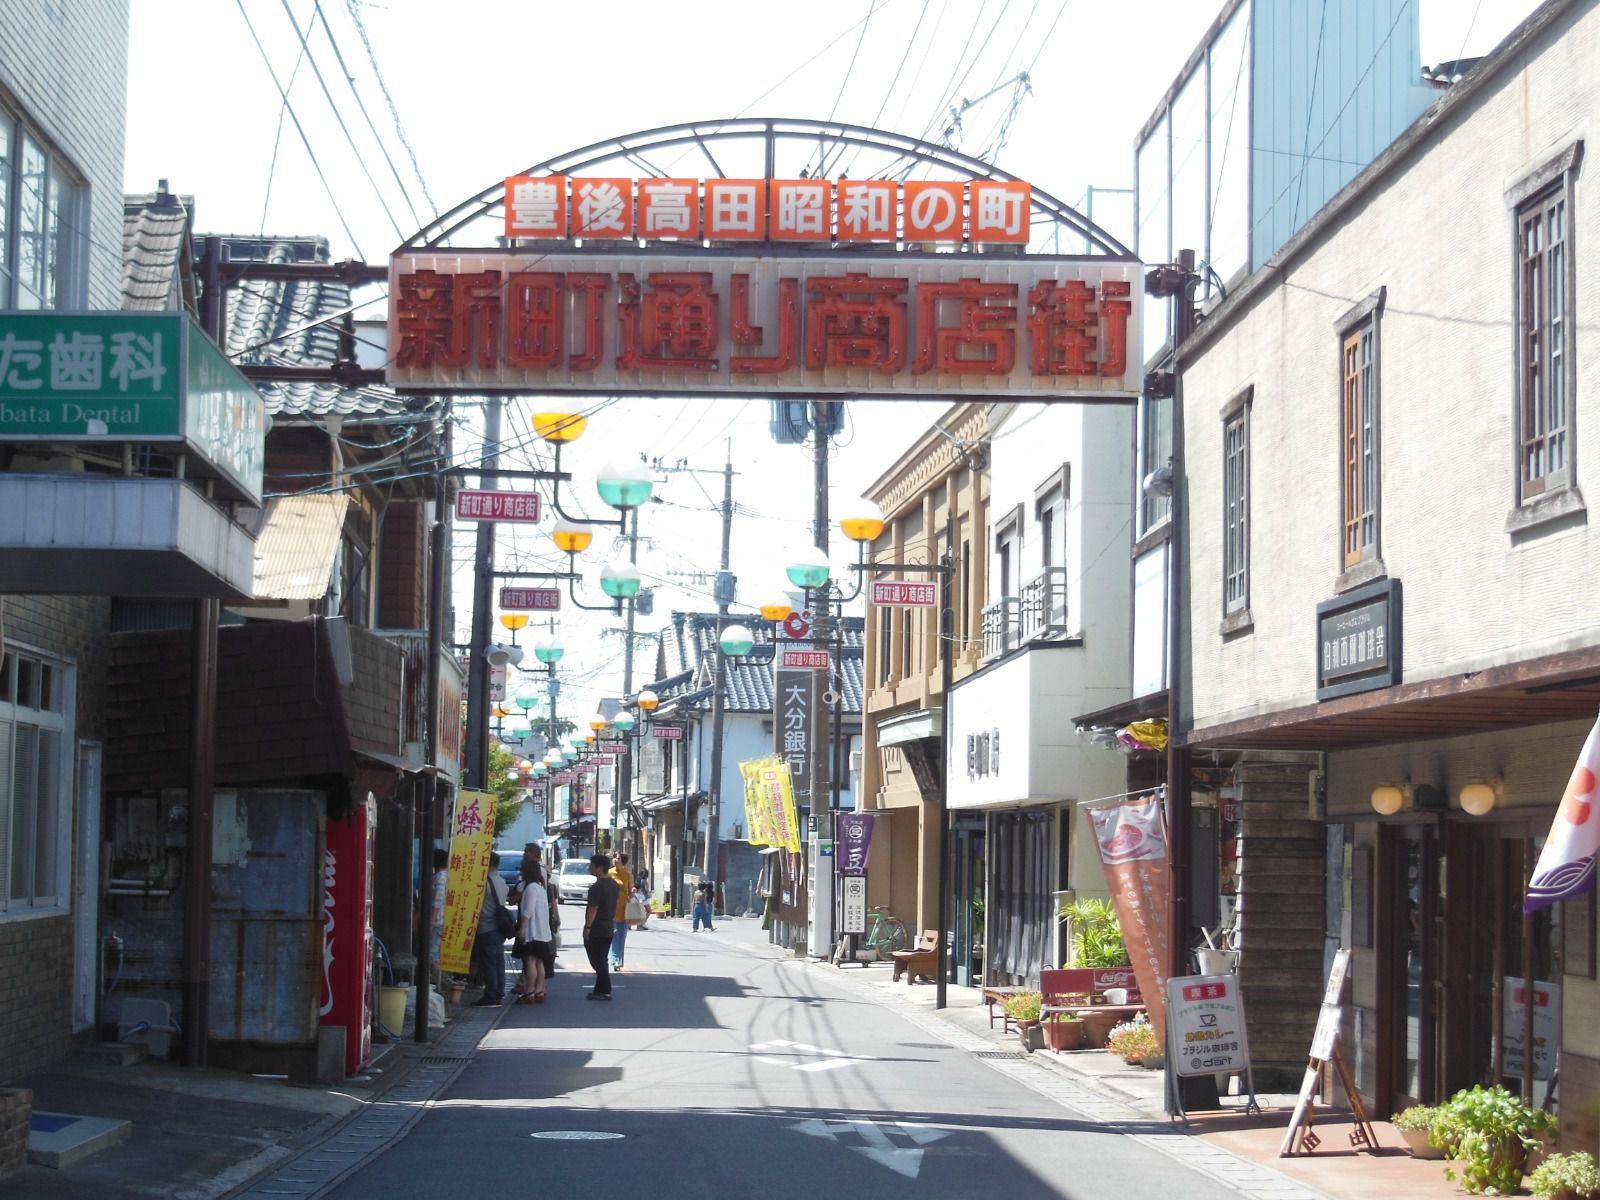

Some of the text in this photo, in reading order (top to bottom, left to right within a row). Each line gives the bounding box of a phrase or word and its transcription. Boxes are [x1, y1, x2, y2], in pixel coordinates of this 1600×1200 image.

[513, 185, 1026, 234] 豊後高田昭和の町
[396, 269, 1131, 376] 新町通り商店街
[0, 330, 168, 393] た歯科
[62, 403, 140, 424] Dental
[460, 495, 537, 518] 新町通り商店街
[504, 591, 559, 607] 新町通り商店街
[875, 584, 935, 603] 新町通り商店街
[784, 685, 807, 776] 大分銀行
